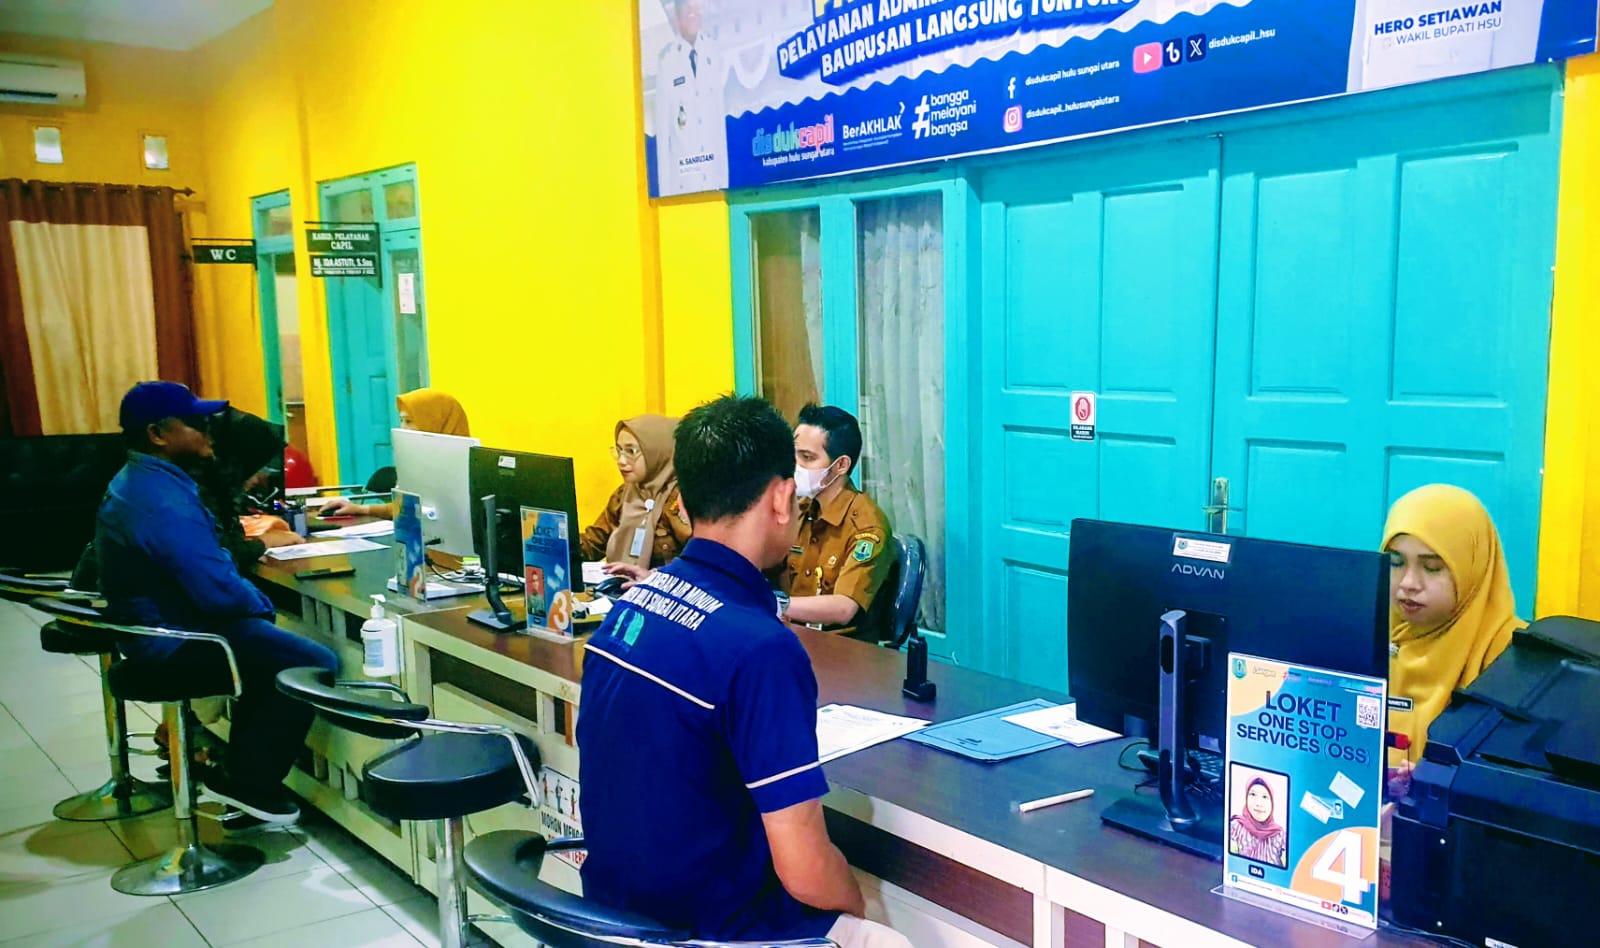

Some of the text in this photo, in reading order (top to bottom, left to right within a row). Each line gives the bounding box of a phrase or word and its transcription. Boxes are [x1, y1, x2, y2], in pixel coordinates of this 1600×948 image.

[1374, 1, 1502, 36] HERO SETIAWAN
[1396, 17, 1502, 45] WAKIL BUPATI HSU
[779, 3, 874, 69] PELAYANAN
[821, 0, 1023, 76] BAURUSAN LANGSUNG
[1077, 63, 1100, 75] sungai
[1101, 60, 1120, 70] utara
[931, 90, 968, 106] bangga
[931, 100, 977, 121] melayani
[752, 113, 834, 156] disdukcapil
[842, 115, 902, 139] BerAKHLAK
[931, 120, 968, 137] bangsa
[210, 249, 237, 261] WC
[330, 241, 354, 250] CAPIL
[1171, 563, 1225, 580] ADVAN
[553, 591, 570, 630] 3
[681, 586, 725, 614] MINUM
[667, 603, 706, 631] UTARA
[1265, 690, 1342, 722] LOKET
[1258, 711, 1347, 741] ONE STOP
[1236, 723, 1370, 768] SERVICES (OSS)
[1250, 866, 1263, 877] IDA
[1312, 829, 1371, 904] 4
